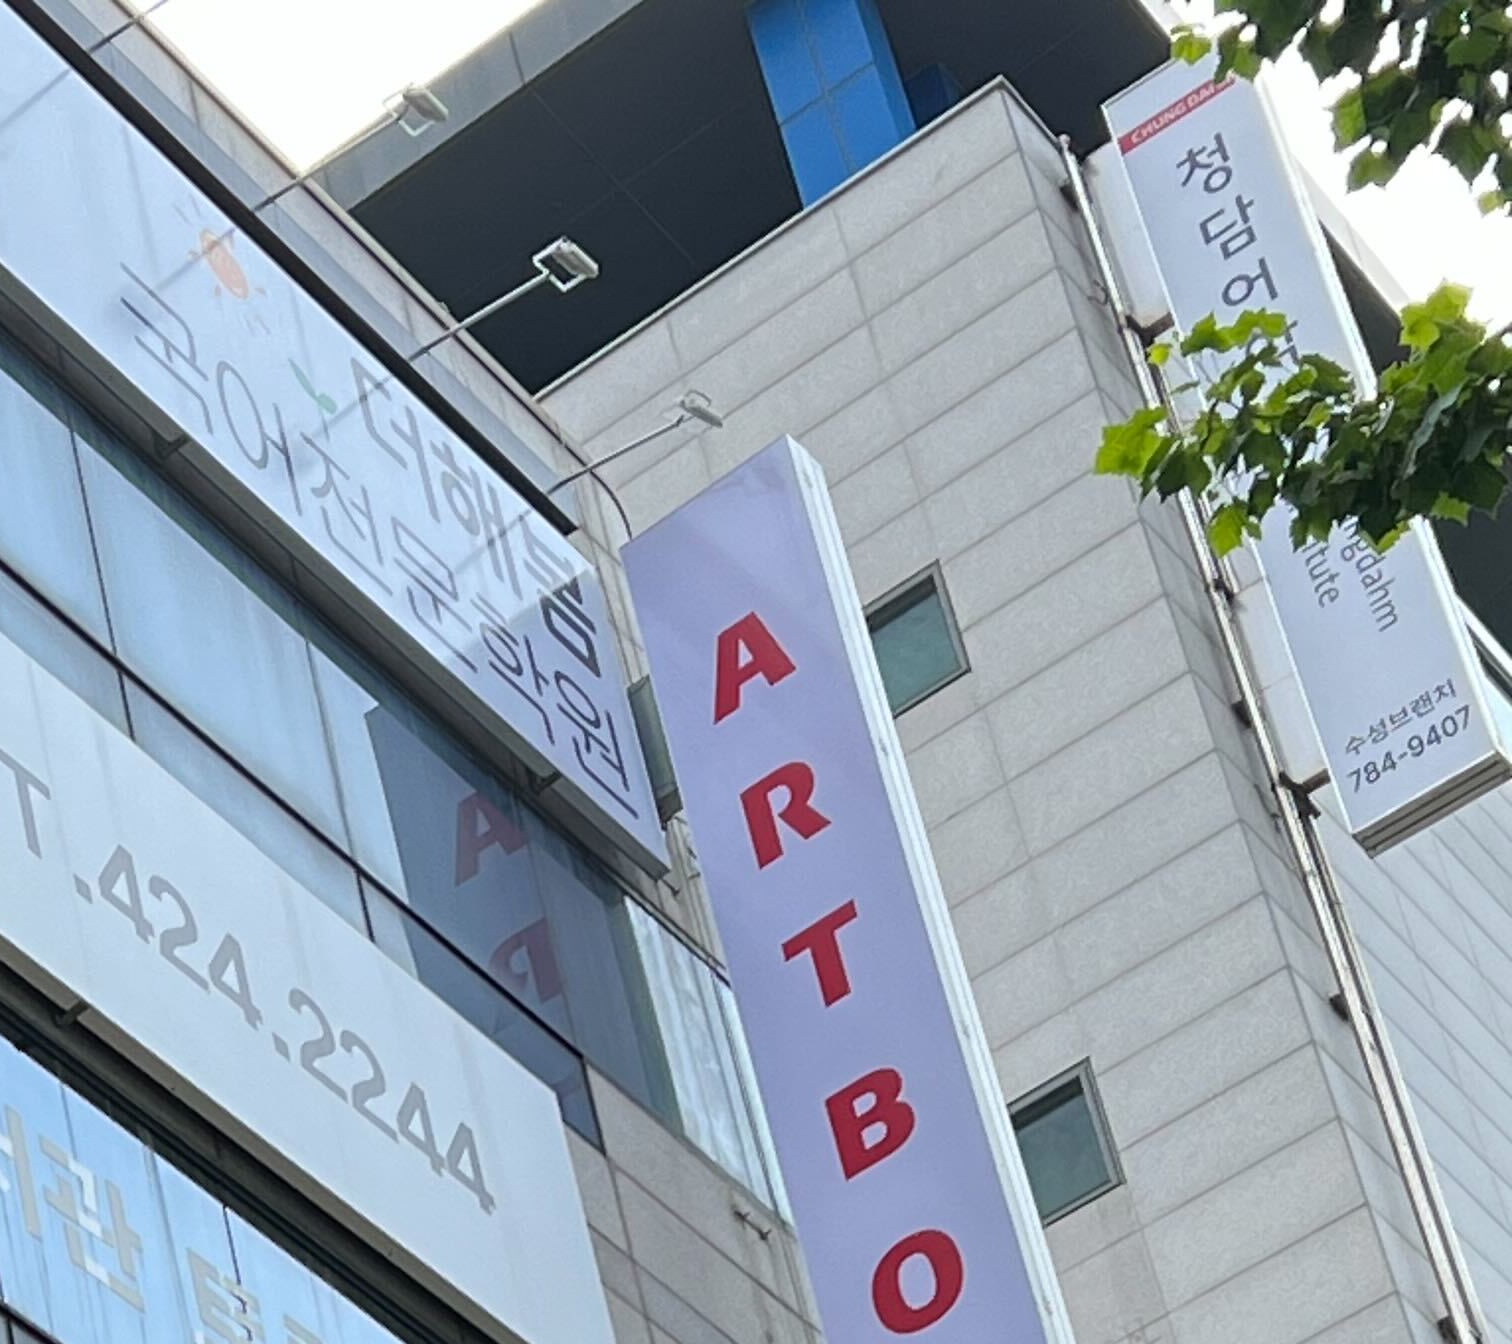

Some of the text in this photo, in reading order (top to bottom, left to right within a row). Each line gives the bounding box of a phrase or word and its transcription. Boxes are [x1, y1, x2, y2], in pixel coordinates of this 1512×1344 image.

[1176, 132, 1300, 366] 청담어
[119, 261, 639, 820] 국어전문학원
[350, 356, 602, 679] 더해봄
[1345, 678, 1457, 756] 수성브랜치
[1345, 704, 1472, 794] 784-9407
